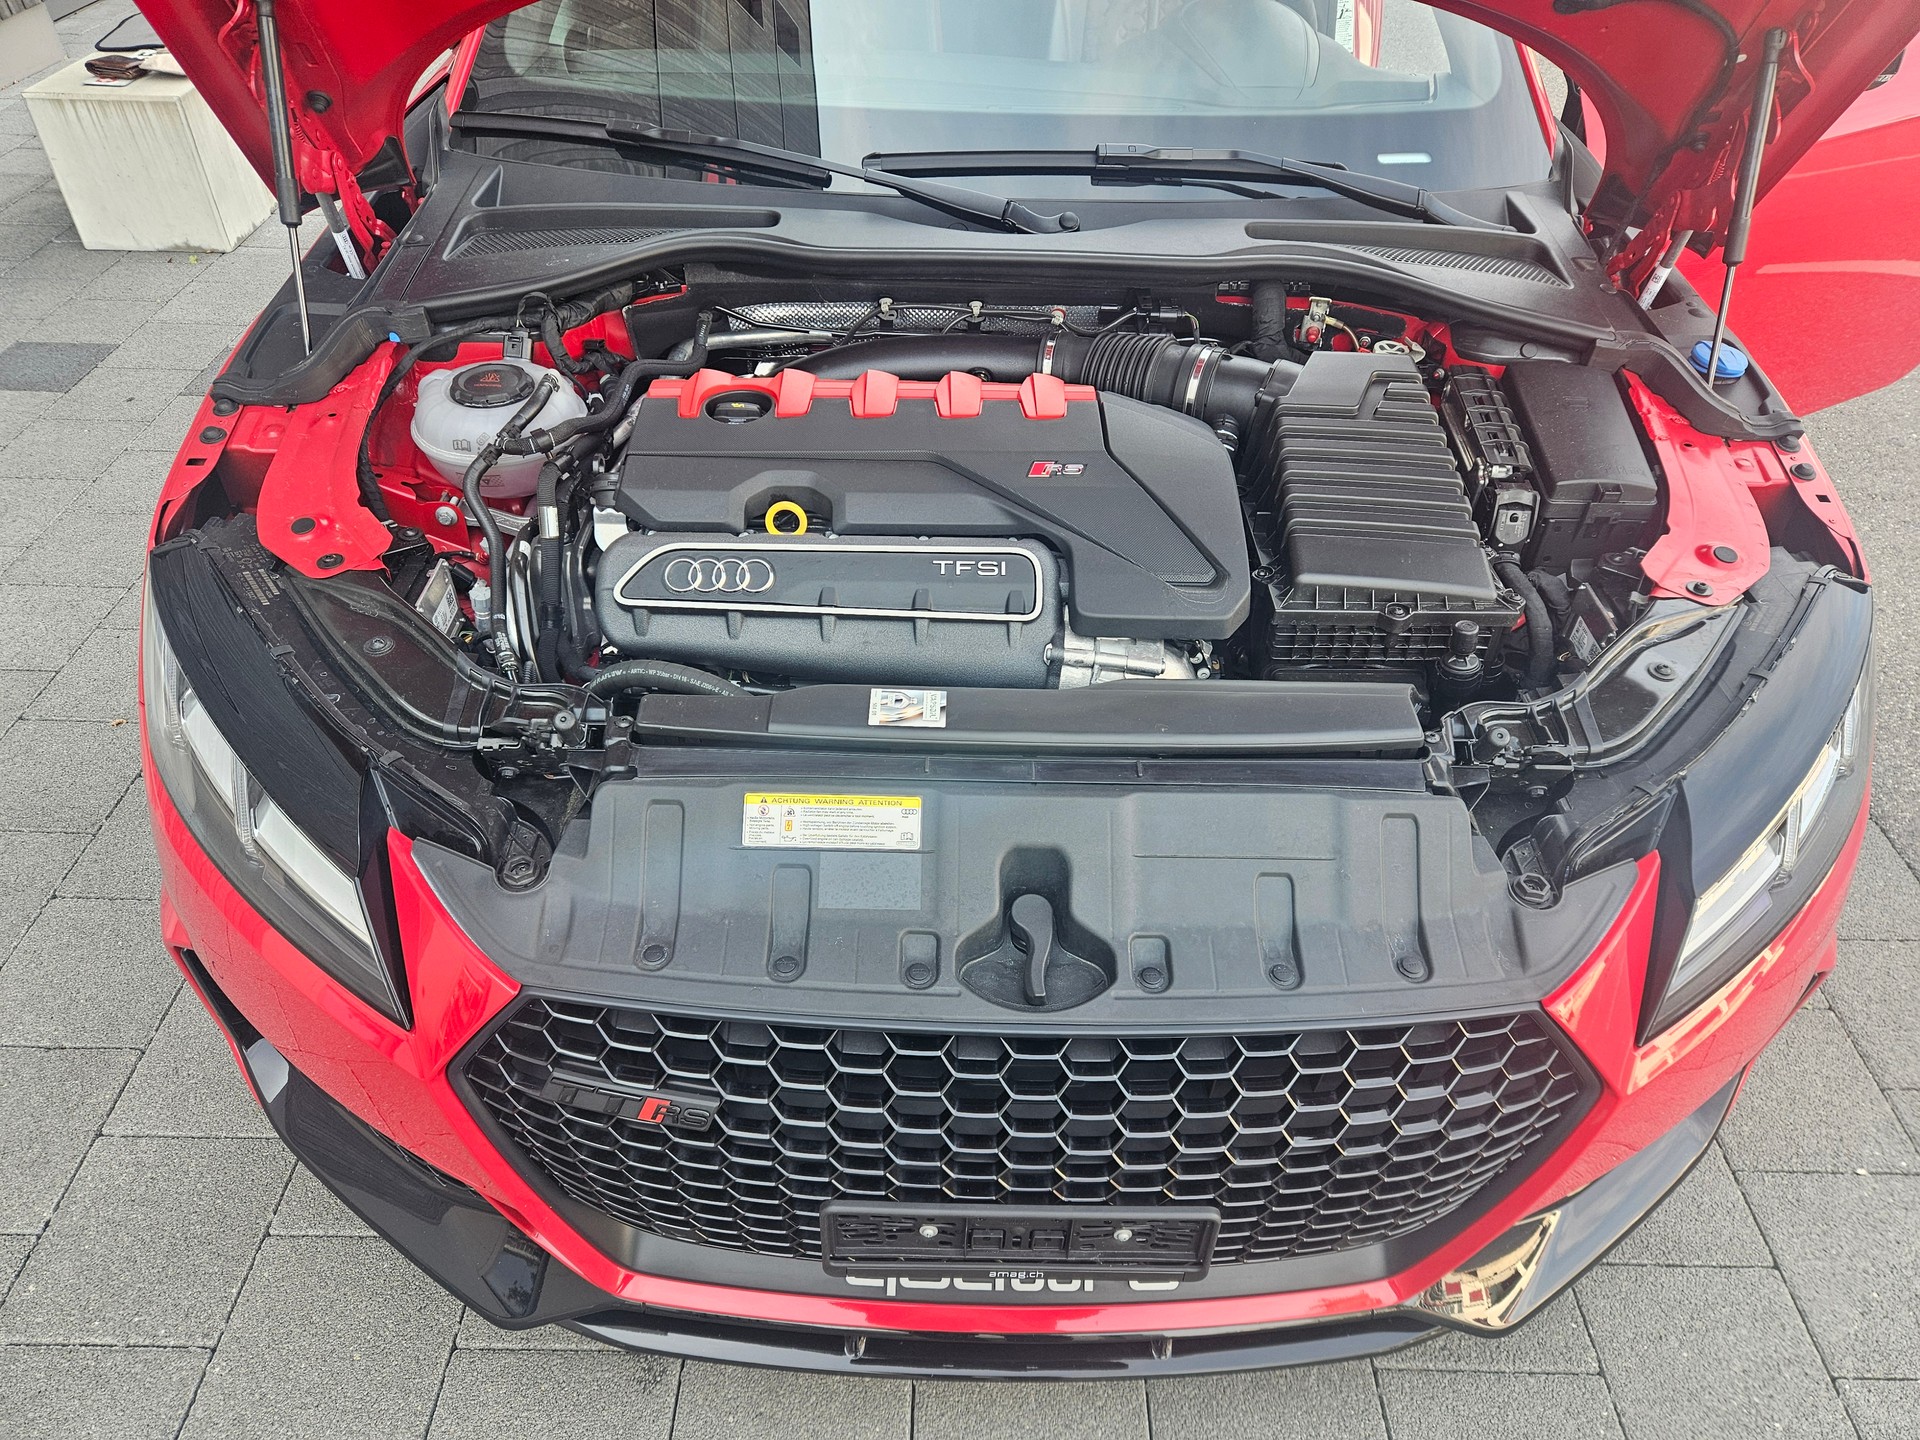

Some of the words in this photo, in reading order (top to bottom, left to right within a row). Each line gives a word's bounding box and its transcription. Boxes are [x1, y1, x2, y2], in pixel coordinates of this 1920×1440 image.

[1035, 462, 1085, 476] RS
[932, 561, 1006, 576] TFSI
[644, 1100, 711, 1127] RS
[988, 1270, 1044, 1279] amag.ch
